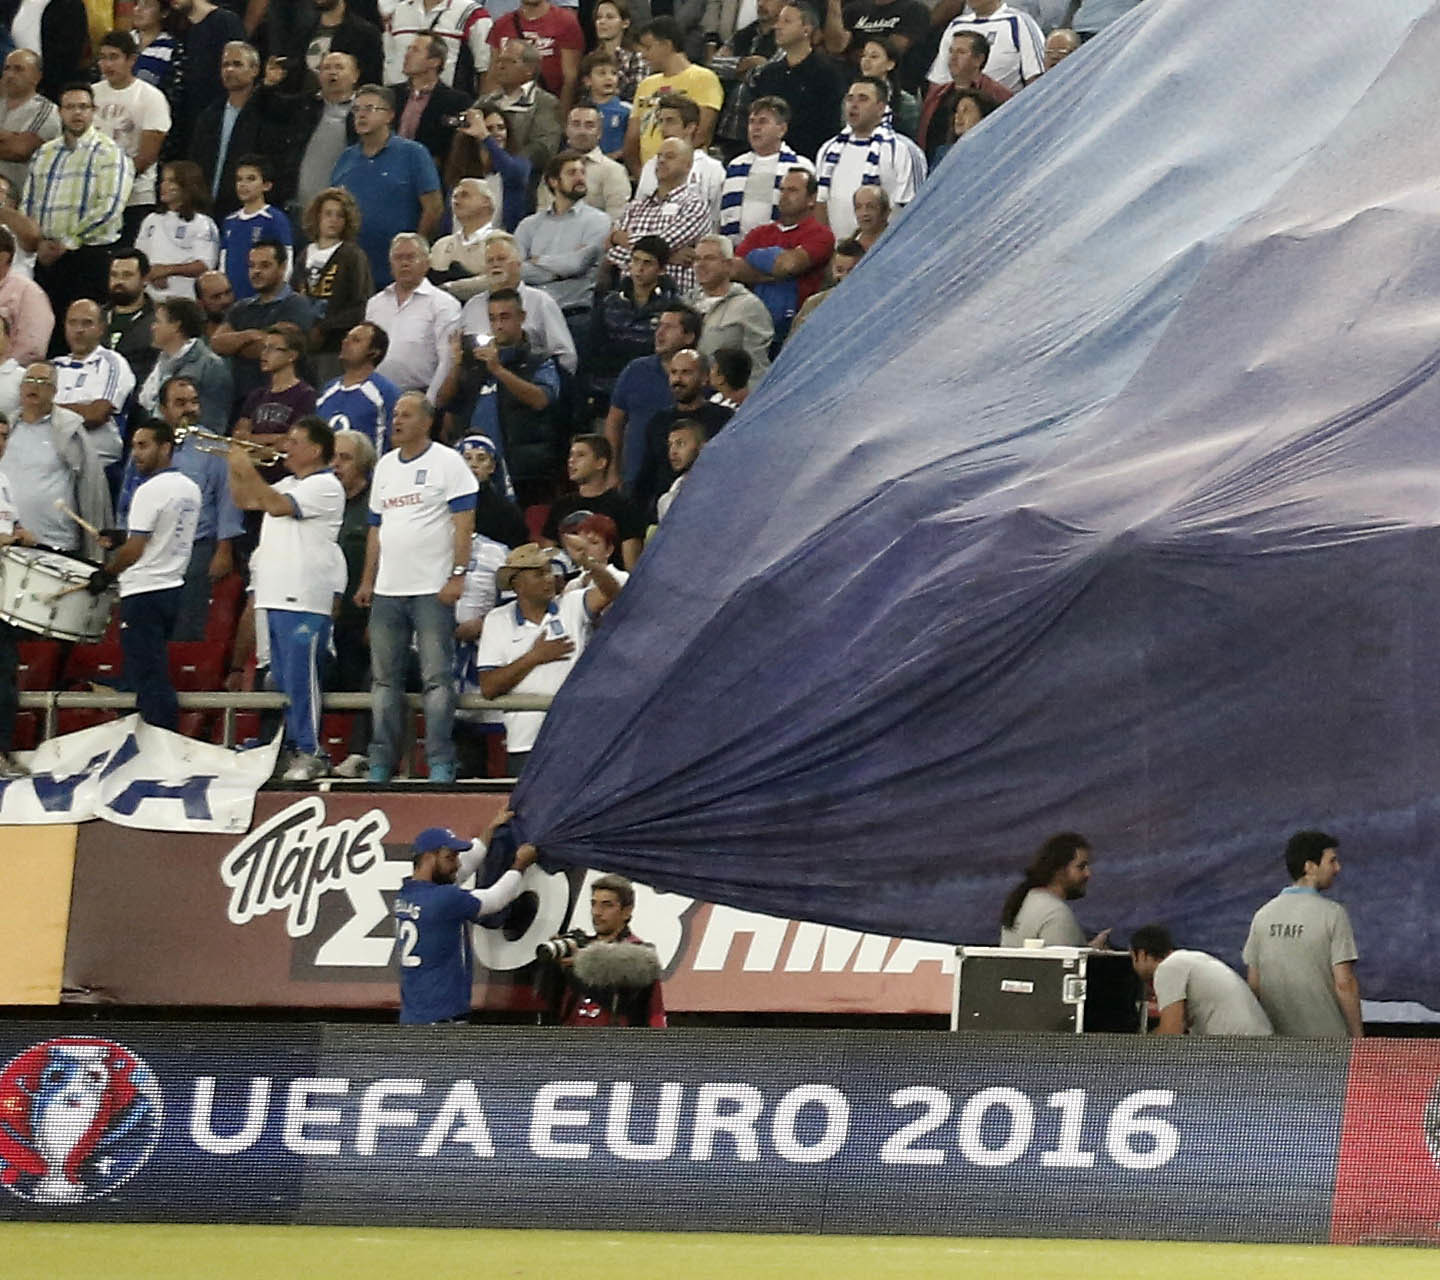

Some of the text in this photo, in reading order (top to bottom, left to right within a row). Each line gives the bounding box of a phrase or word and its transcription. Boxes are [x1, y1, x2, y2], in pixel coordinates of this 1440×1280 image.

[1269, 923, 1305, 939] STAFF
[187, 1076, 1181, 1172] UEFA EURO 2016
